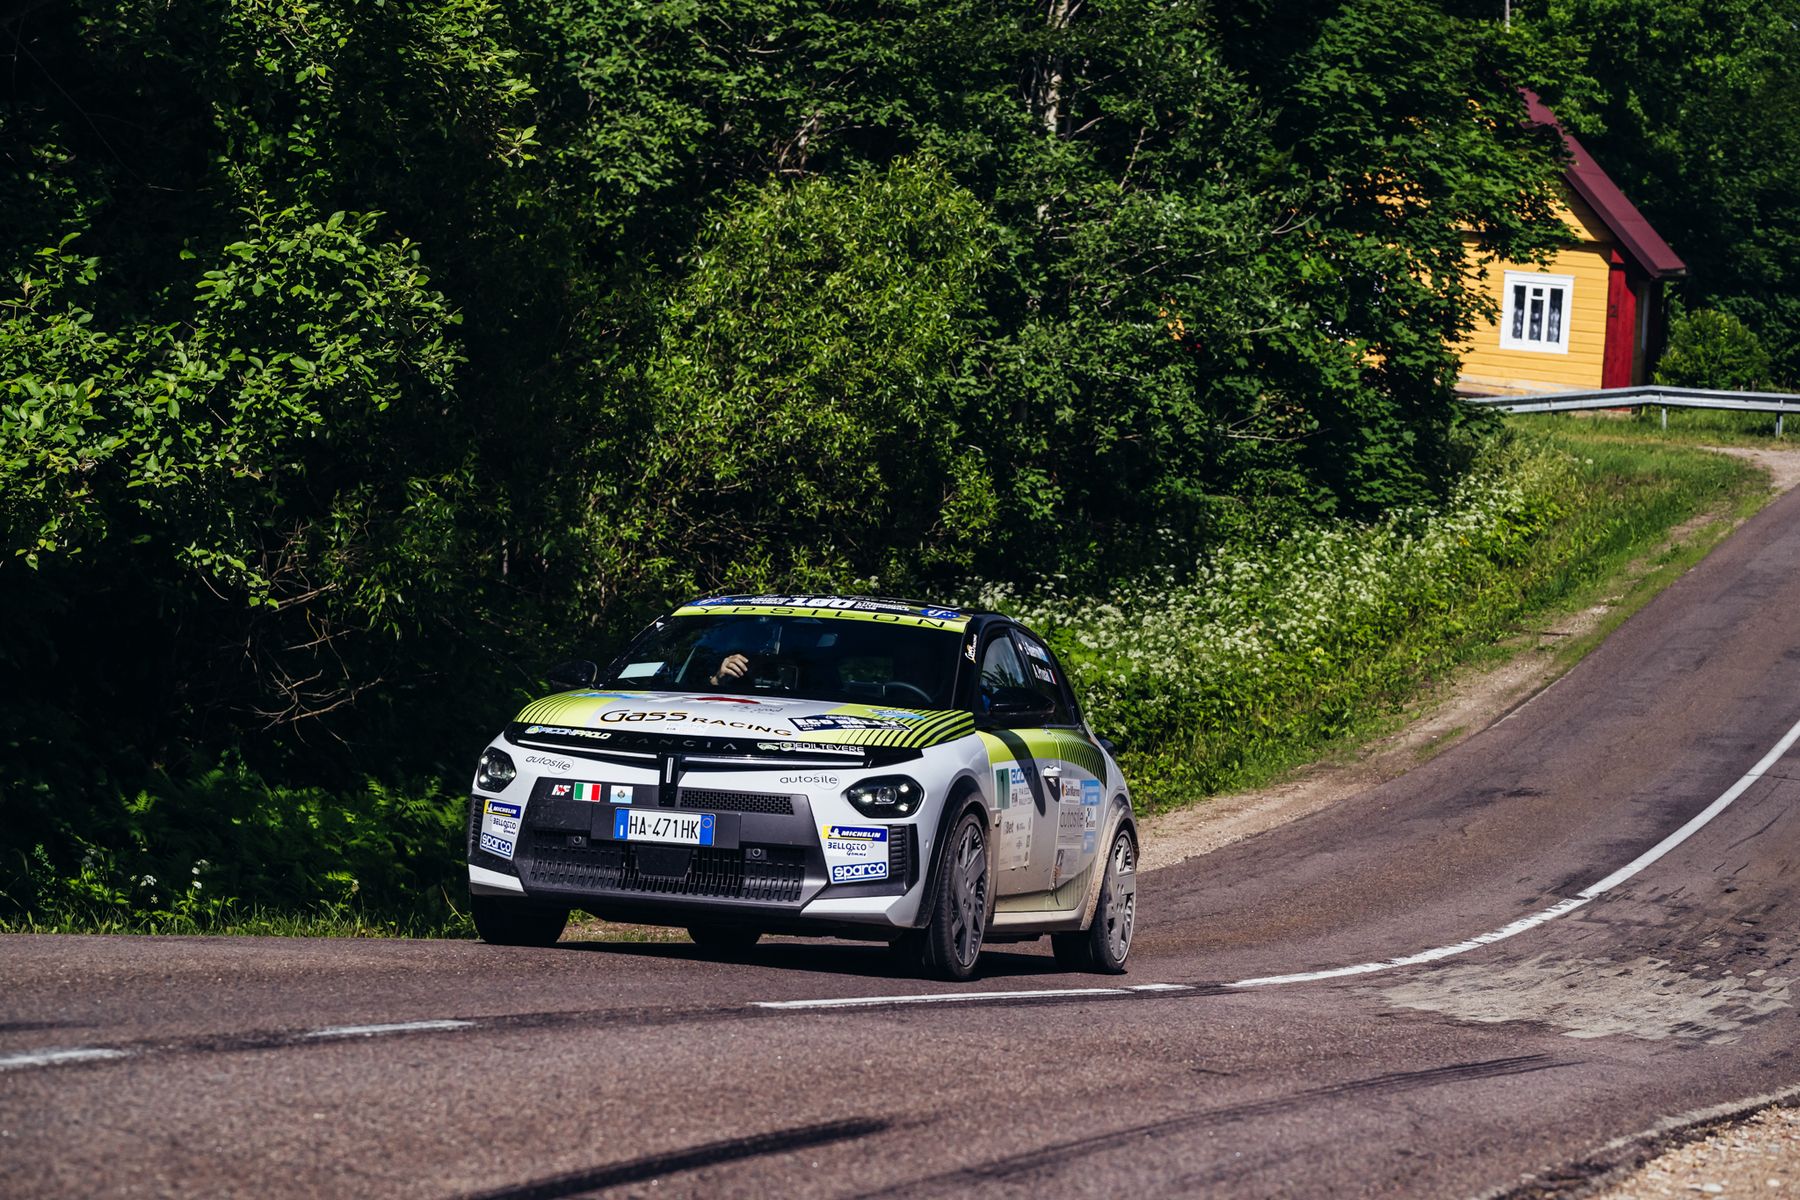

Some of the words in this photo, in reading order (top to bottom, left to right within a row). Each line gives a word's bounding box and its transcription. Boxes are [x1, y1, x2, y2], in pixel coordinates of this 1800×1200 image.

[699, 606, 945, 628] YPSILON
[692, 716, 792, 737] RACING
[618, 735, 737, 750] LANCIA
[795, 742, 865, 753] EDILTEVERE
[525, 755, 571, 771] autosile
[779, 775, 838, 784] autosile
[493, 805, 517, 815] MICHELIN
[841, 830, 881, 838] MICHELIN
[481, 834, 512, 854] sparco
[827, 841, 867, 851] BELLOTTO
[833, 864, 886, 880] sparco
